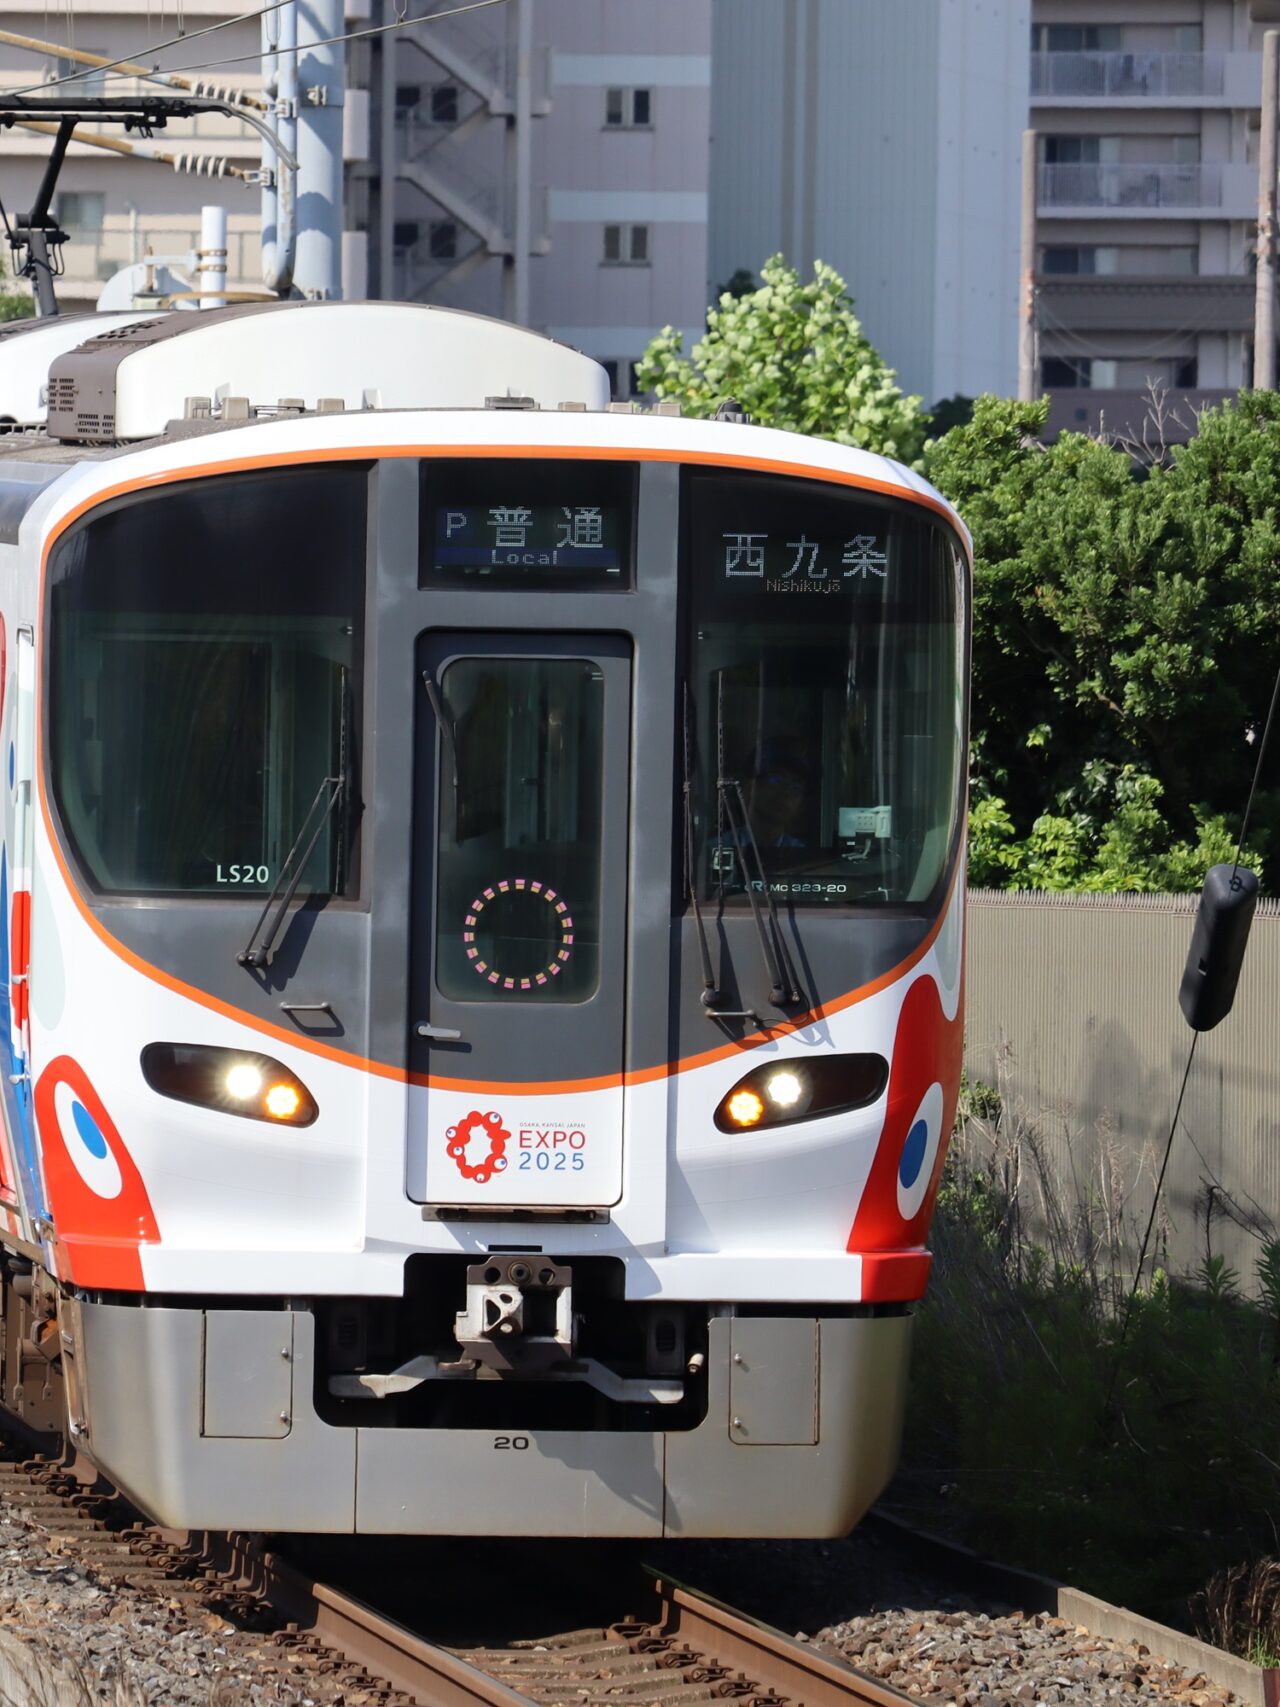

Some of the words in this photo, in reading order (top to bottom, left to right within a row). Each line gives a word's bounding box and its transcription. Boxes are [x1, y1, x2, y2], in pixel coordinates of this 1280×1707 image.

[446, 512, 468, 538] P
[487, 506, 603, 548] 普通
[491, 549, 558, 565] Local
[722, 532, 888, 579] 西九条
[216, 864, 269, 884] LS20
[791, 883, 847, 893] 323-20
[519, 1130, 586, 1149] EXPO
[519, 1151, 585, 1171] 2025
[493, 1436, 529, 1450] 20
